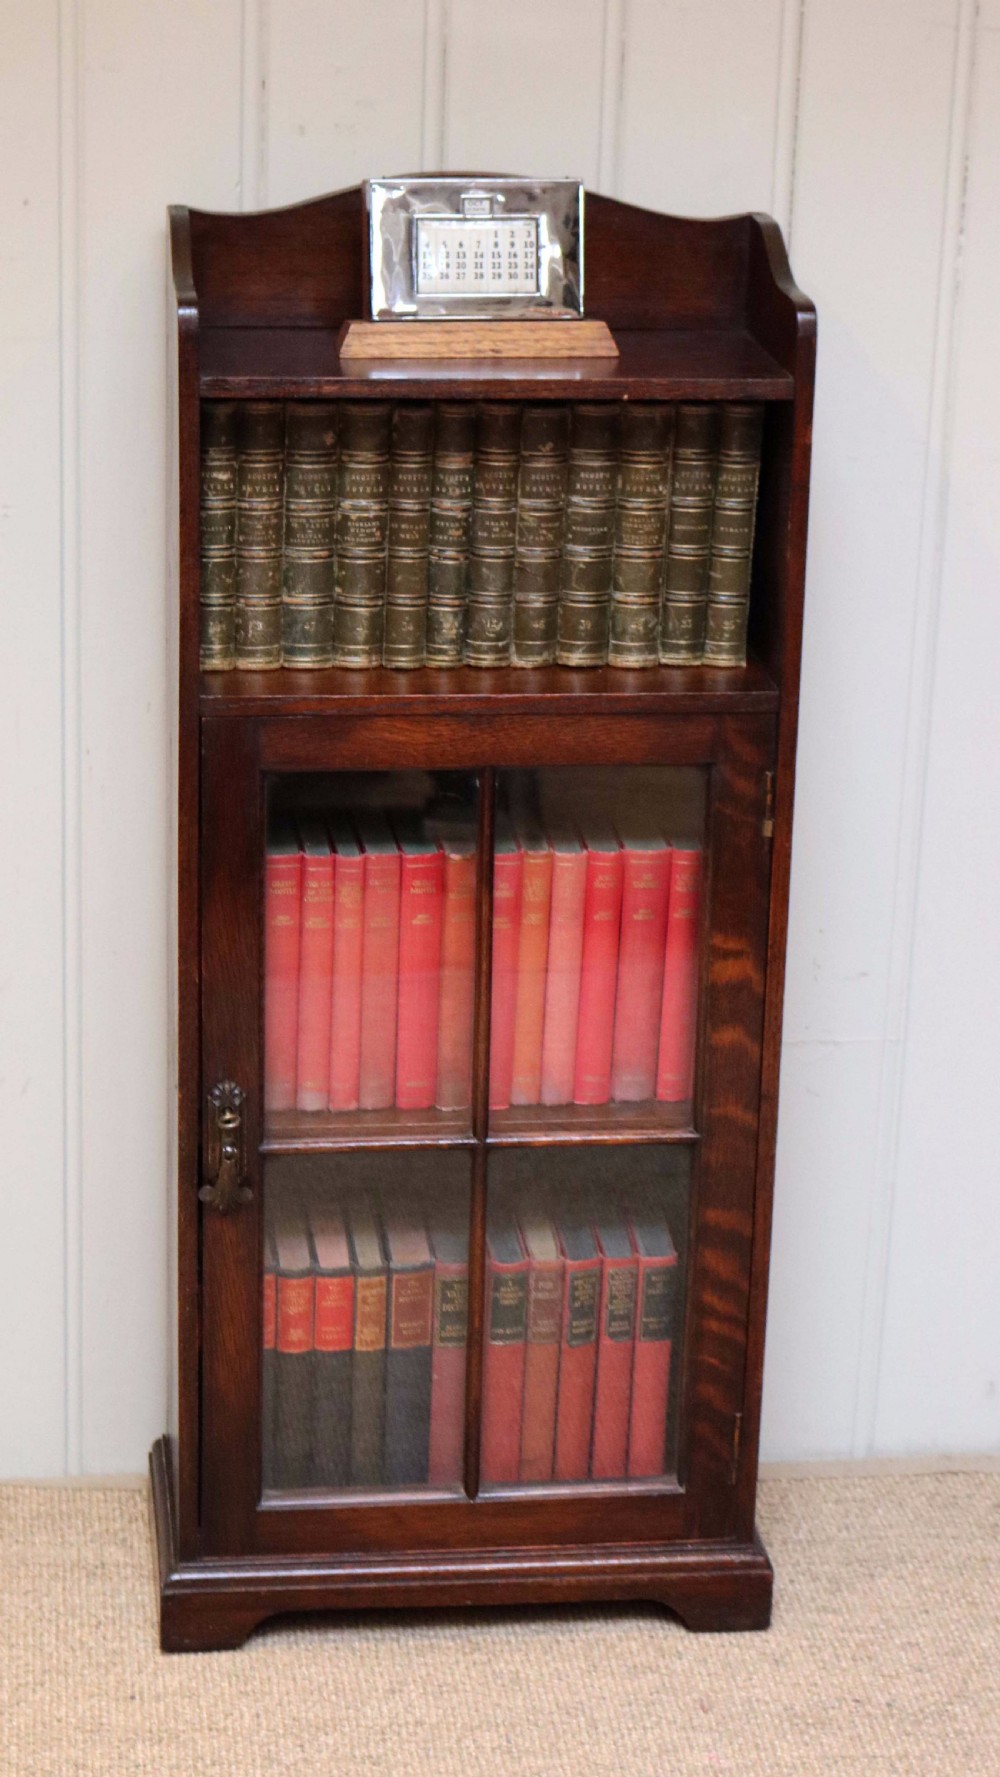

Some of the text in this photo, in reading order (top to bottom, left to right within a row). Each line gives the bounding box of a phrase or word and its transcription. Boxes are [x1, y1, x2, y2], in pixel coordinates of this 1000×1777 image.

[524, 240, 534, 249] 10
[456, 251, 466, 259] 13
[474, 251, 484, 259] 14
[491, 251, 502, 259] 15
[508, 251, 518, 259] 16
[524, 251, 534, 259] 17
[456, 261, 466, 270] 20
[474, 261, 484, 270] 21
[491, 261, 502, 270] 22
[508, 261, 518, 270] 23
[524, 261, 534, 270] 24
[439, 272, 450, 280] 26
[456, 272, 466, 280] 27
[474, 272, 484, 280] 28
[491, 272, 502, 280] 29
[508, 272, 518, 280] 30
[524, 272, 534, 280] 31
